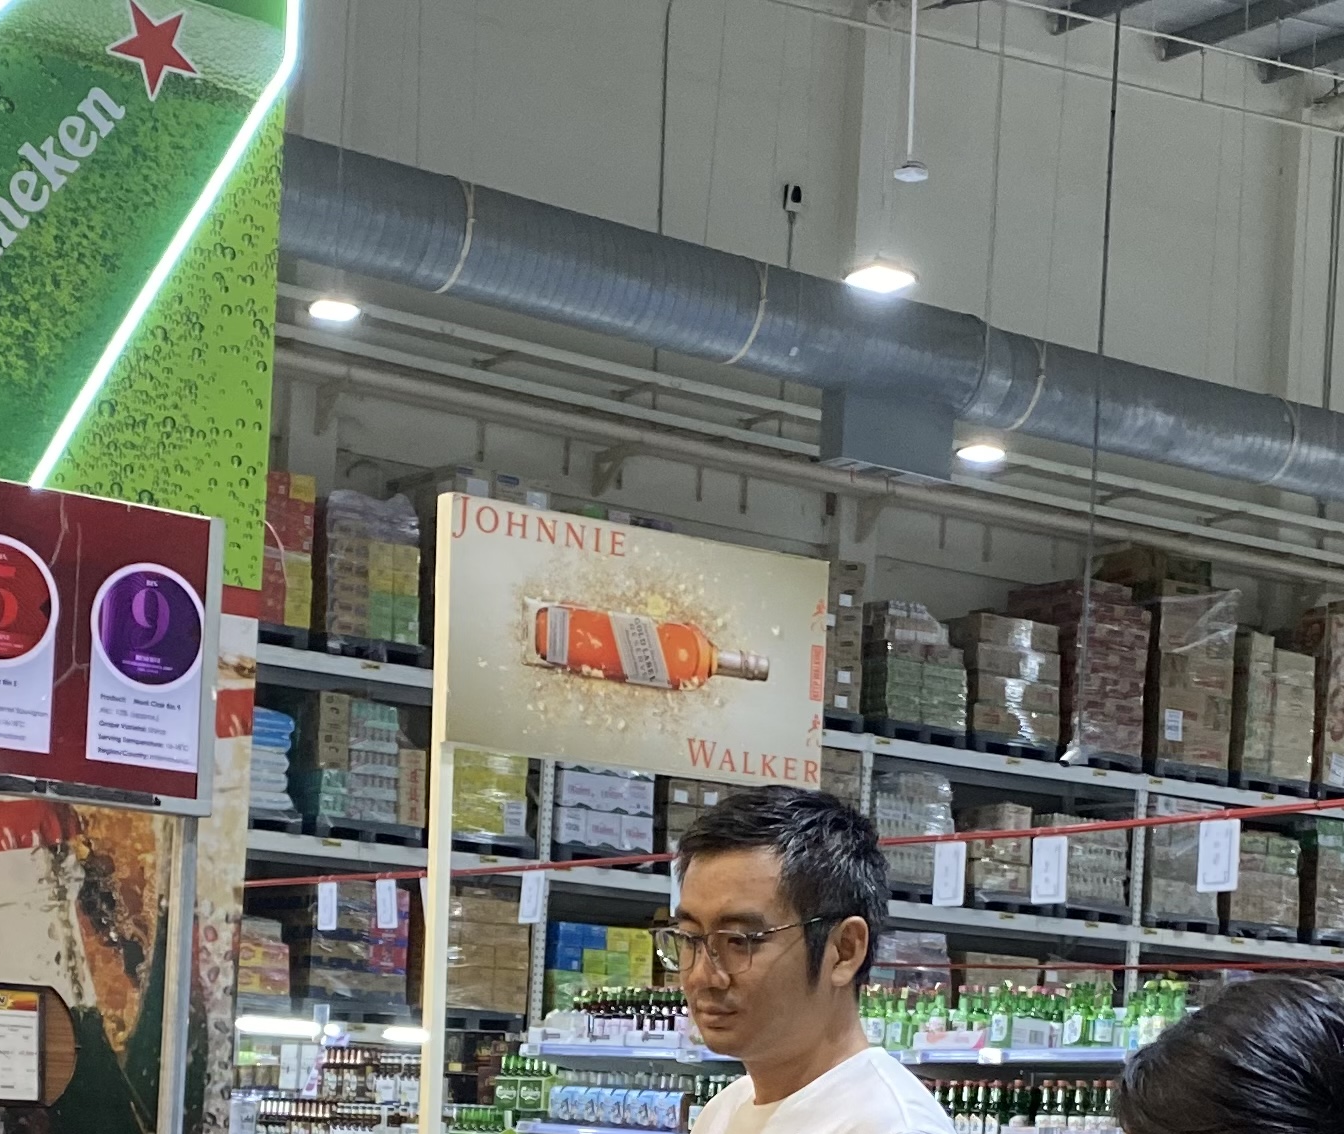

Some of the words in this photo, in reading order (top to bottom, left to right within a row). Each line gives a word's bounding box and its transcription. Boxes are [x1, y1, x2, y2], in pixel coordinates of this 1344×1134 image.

[451, 496, 627, 557] JOHNNIE
[131, 588, 170, 649] 9
[686, 737, 819, 784] WALKER
